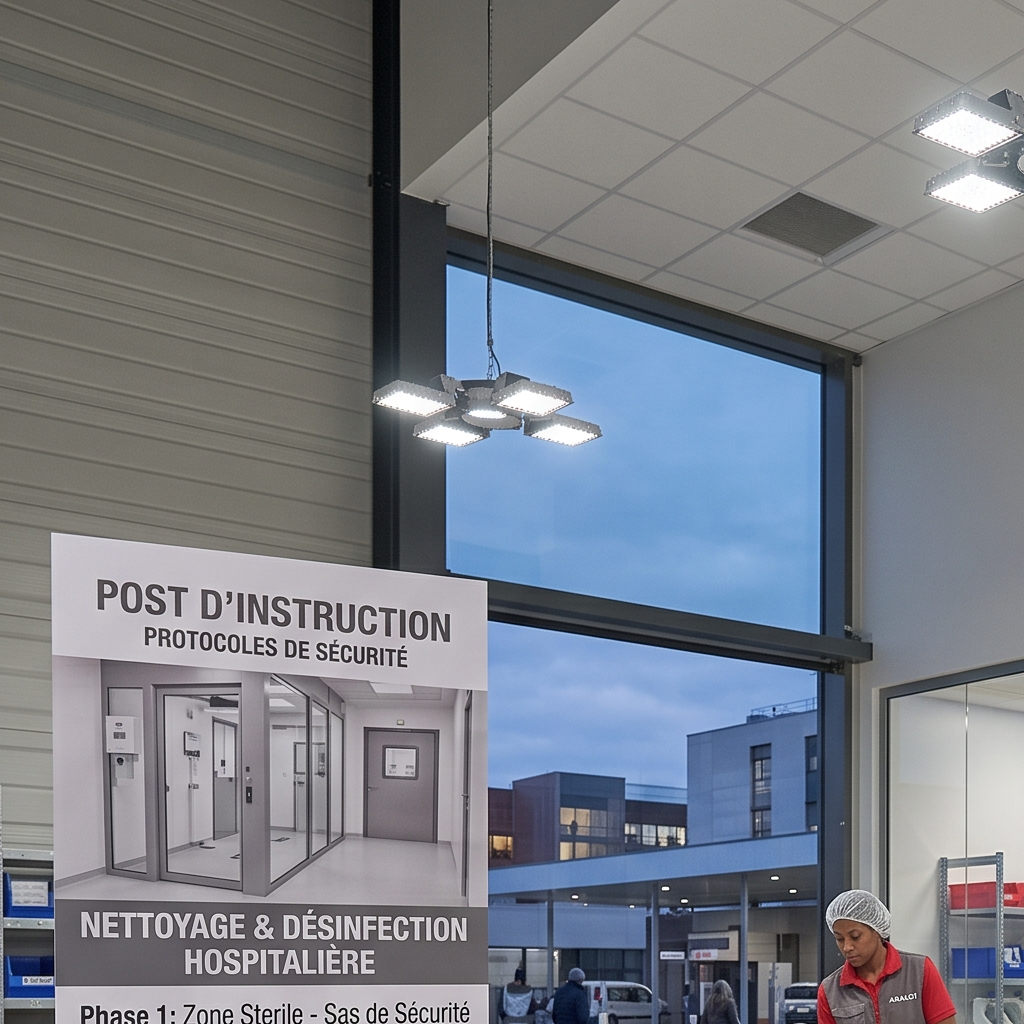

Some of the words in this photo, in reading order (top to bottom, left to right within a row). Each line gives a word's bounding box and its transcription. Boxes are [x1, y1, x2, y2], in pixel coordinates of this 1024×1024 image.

[97, 579, 188, 617] POST
[145, 627, 278, 656] PROTOCOLES
[285, 639, 309, 659] DE
[316, 639, 408, 668] SÉCURITÉ
[80, 911, 245, 939] NETTOYAGE
[253, 914, 275, 940] &
[283, 909, 467, 942] DÉSINFECTION
[185, 943, 375, 975] HOSPITALIÈRE
[366, 1002, 389, 1024] de
[395, 1001, 470, 1024] Sécurité
